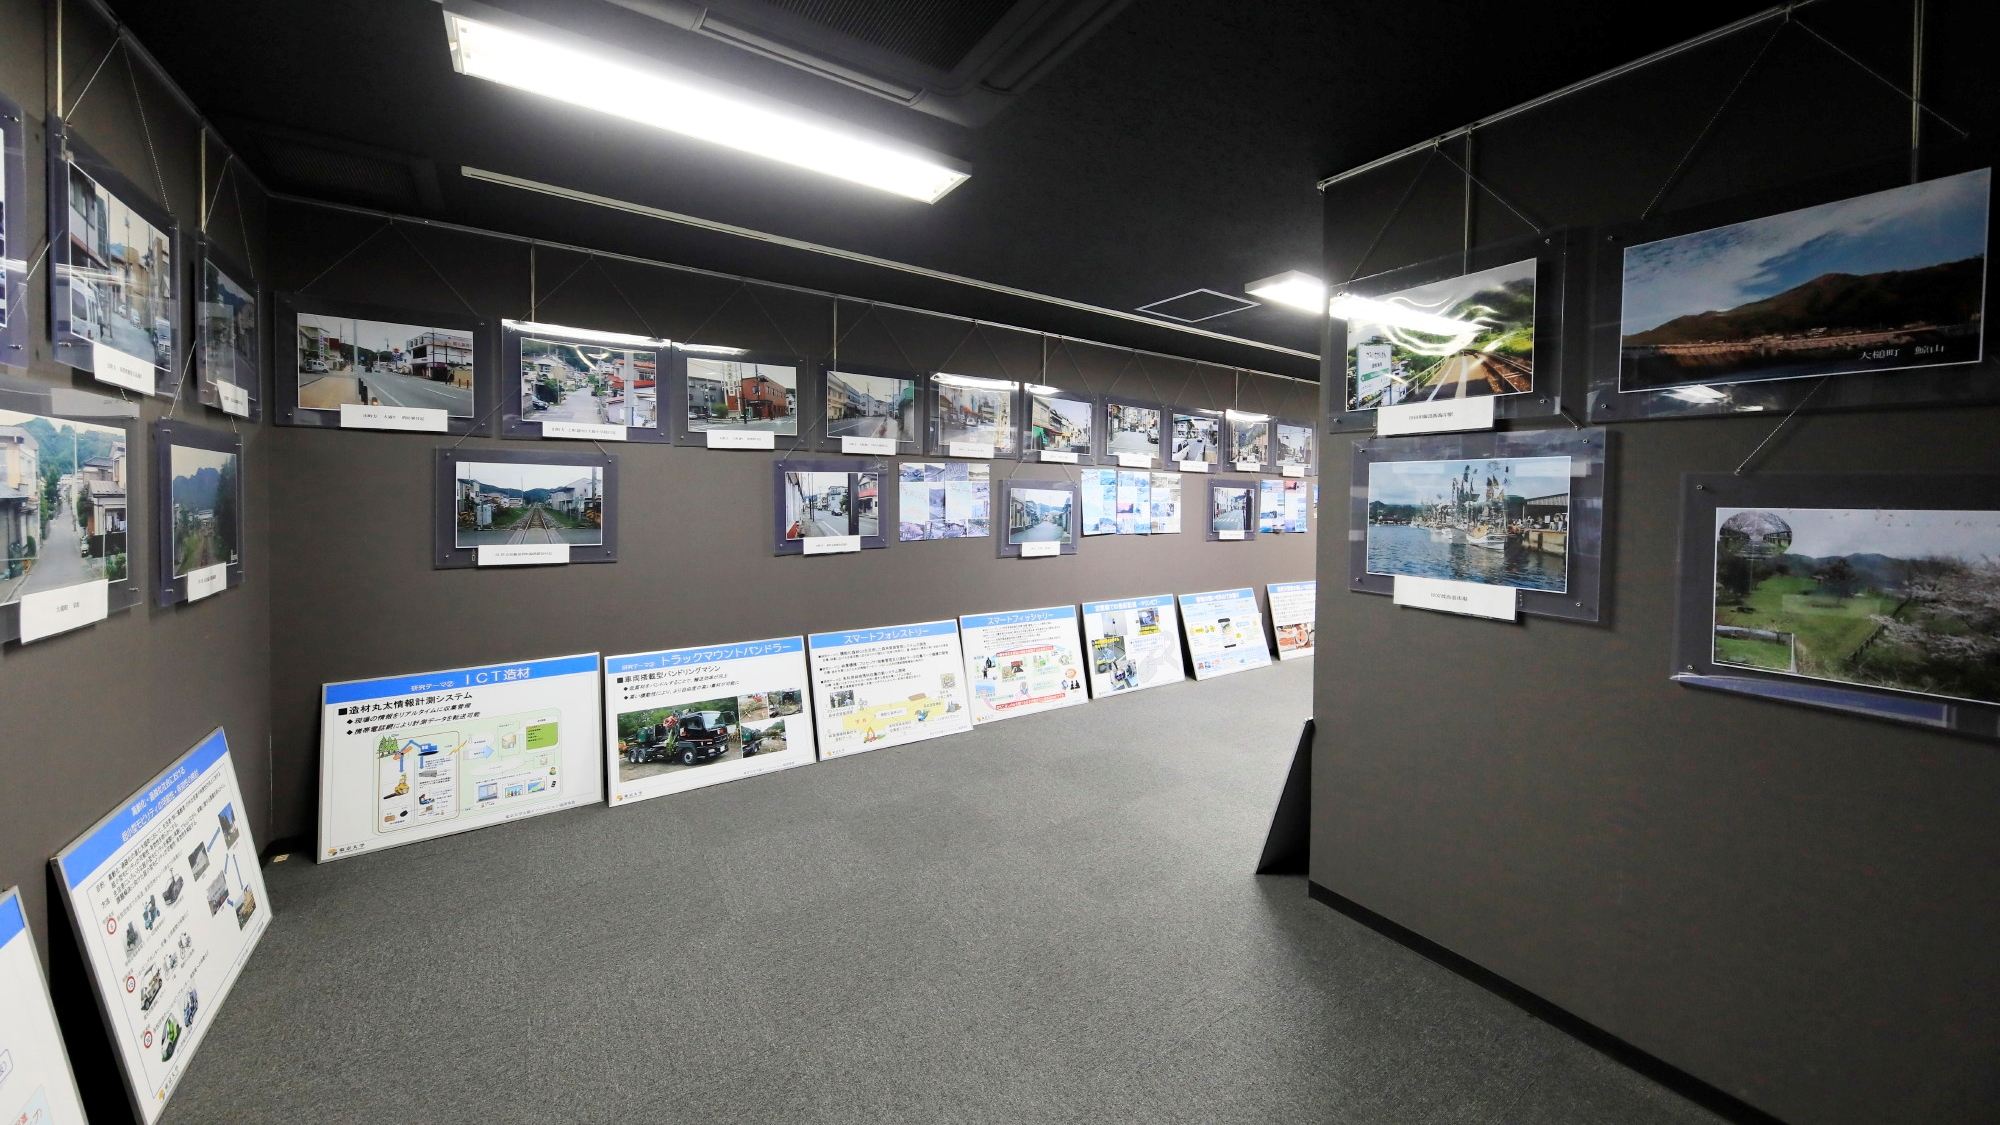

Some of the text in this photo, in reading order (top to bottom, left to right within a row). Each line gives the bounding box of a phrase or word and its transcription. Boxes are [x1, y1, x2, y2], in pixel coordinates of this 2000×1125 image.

[844, 629, 929, 644] スマートフォレストリー
[348, 692, 473, 715] 造材丸太情報計測システム
